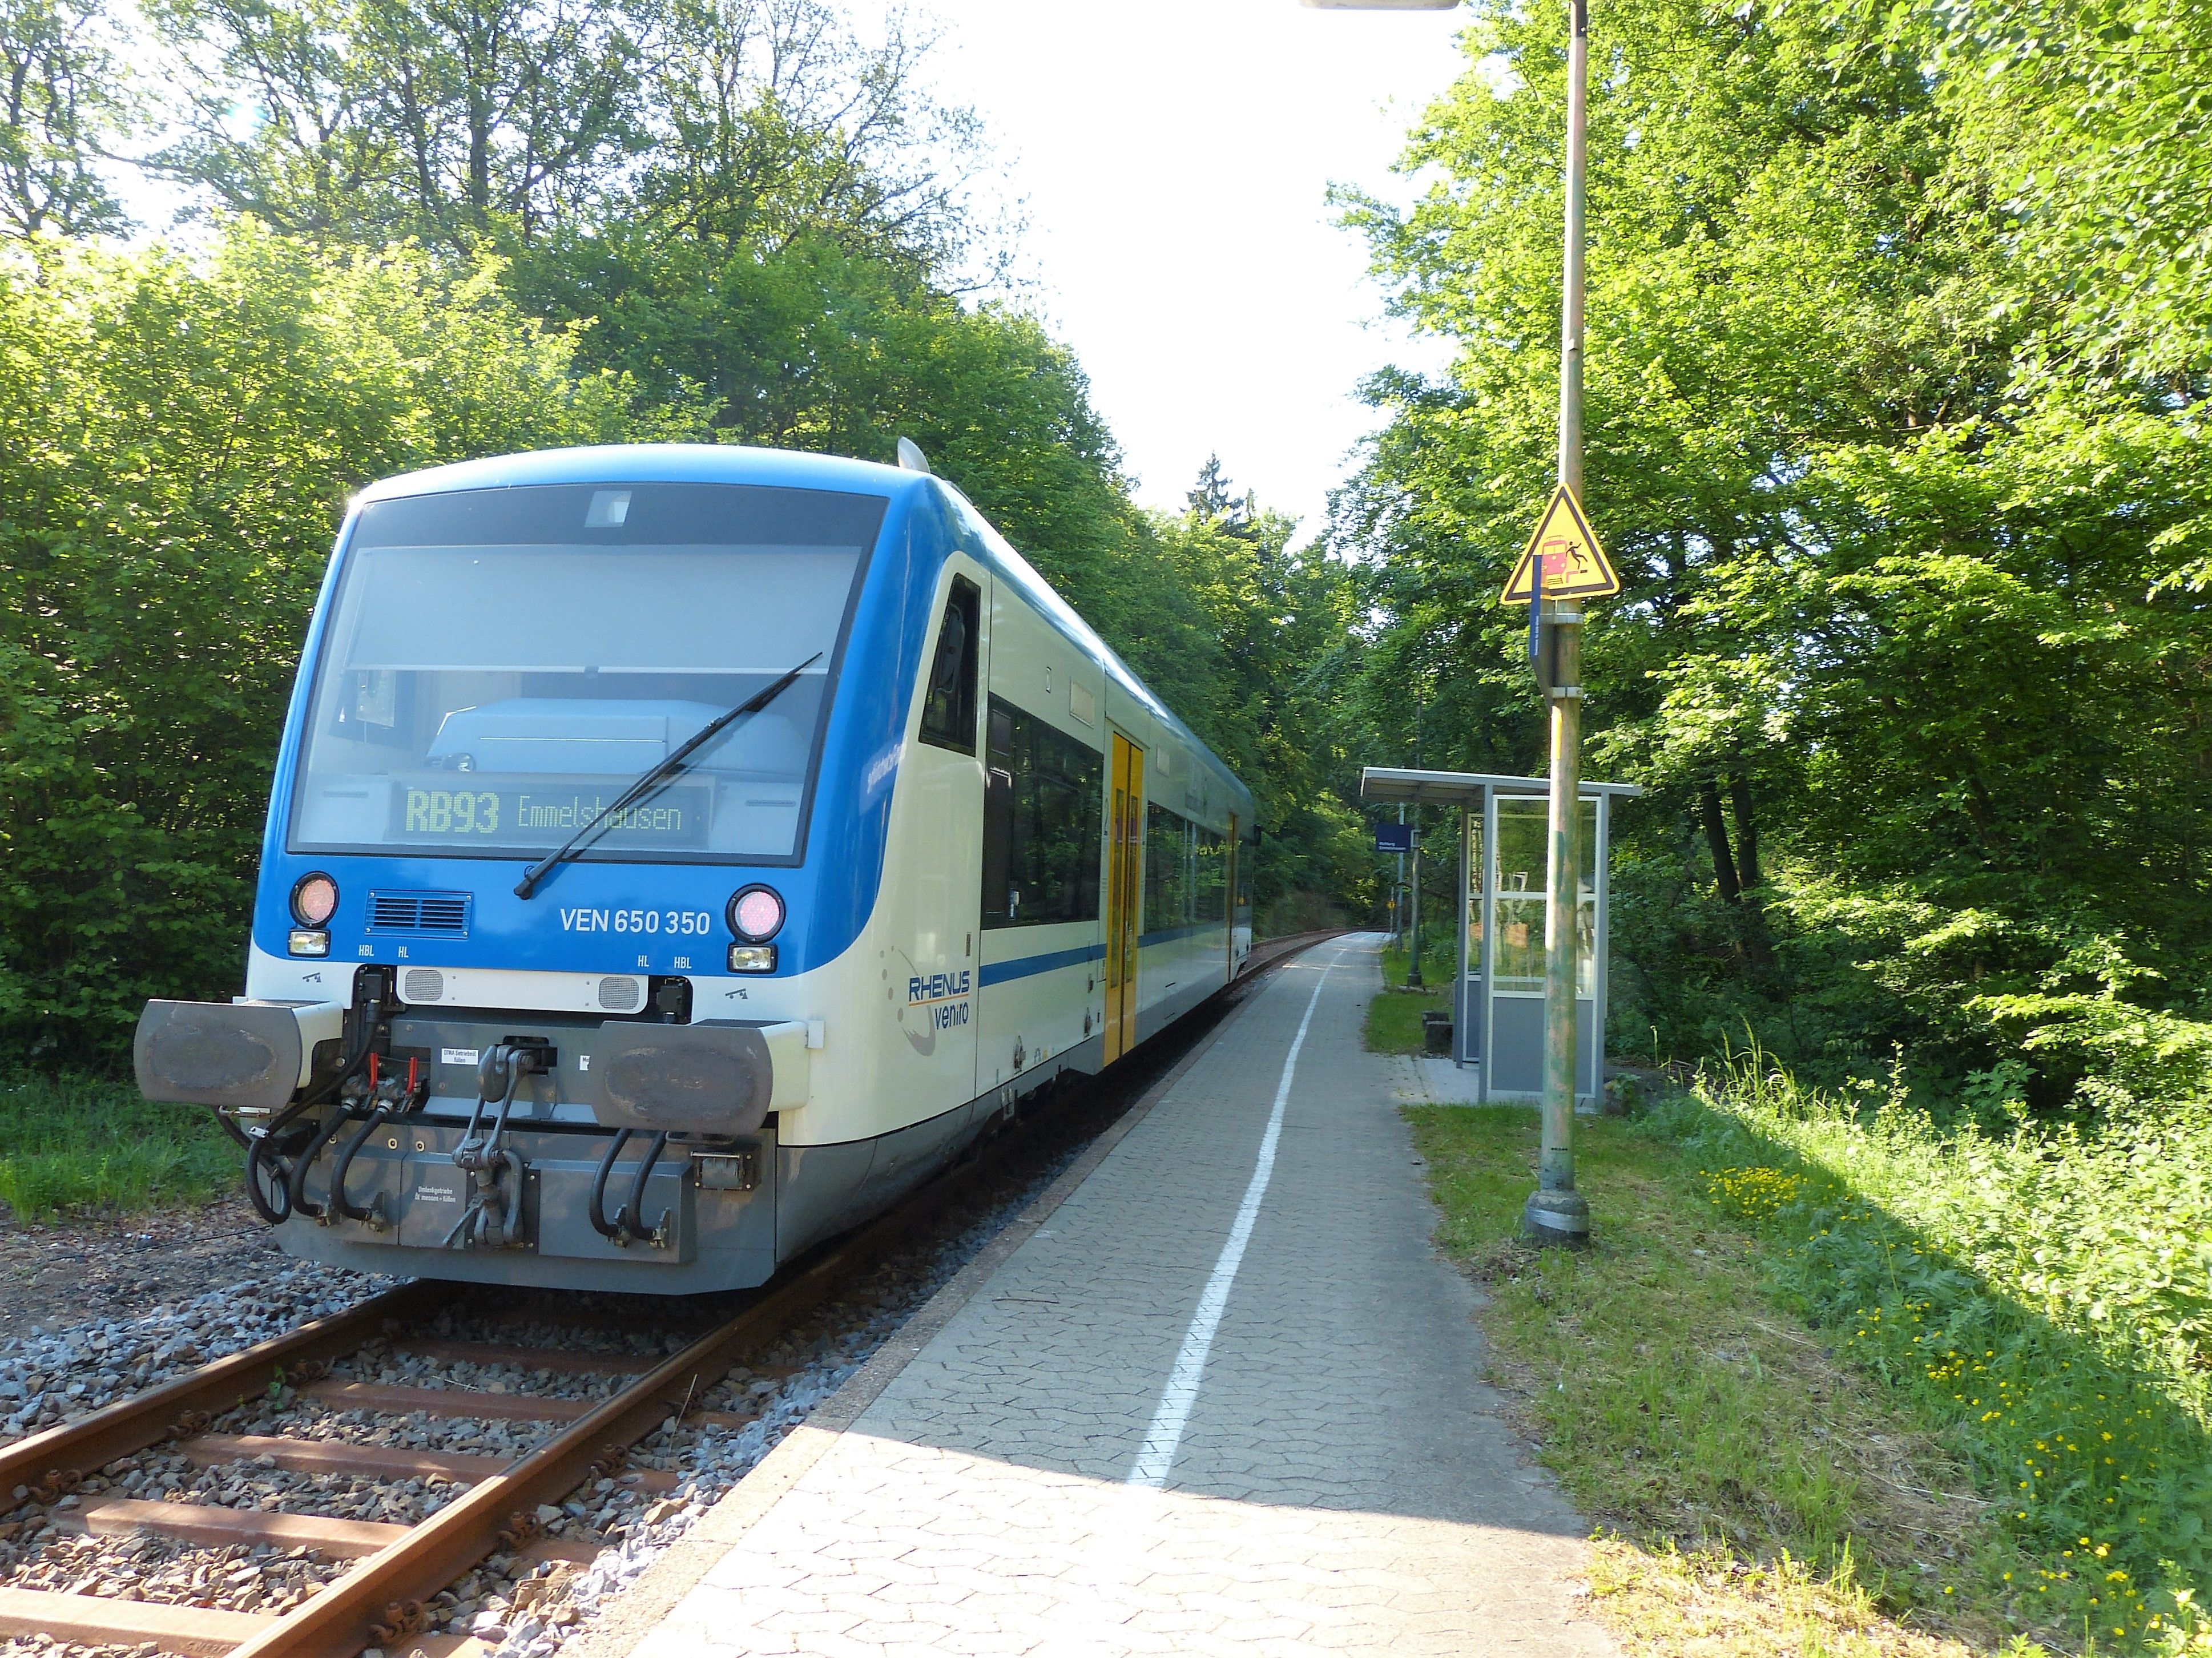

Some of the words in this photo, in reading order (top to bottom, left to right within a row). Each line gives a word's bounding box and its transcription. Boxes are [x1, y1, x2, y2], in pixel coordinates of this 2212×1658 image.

[406, 790, 499, 833] RB93
[518, 795, 682, 830] Emmelshausen
[560, 908, 609, 931] VEN
[614, 910, 659, 933] 650
[665, 911, 710, 935] 350
[358, 945, 374, 957] HBL
[398, 946, 409, 958] HL
[638, 955, 650, 967] HL
[674, 957, 692, 969] HBL
[908, 970, 970, 1002] RHENUS
[935, 1002, 969, 1030] veniro
